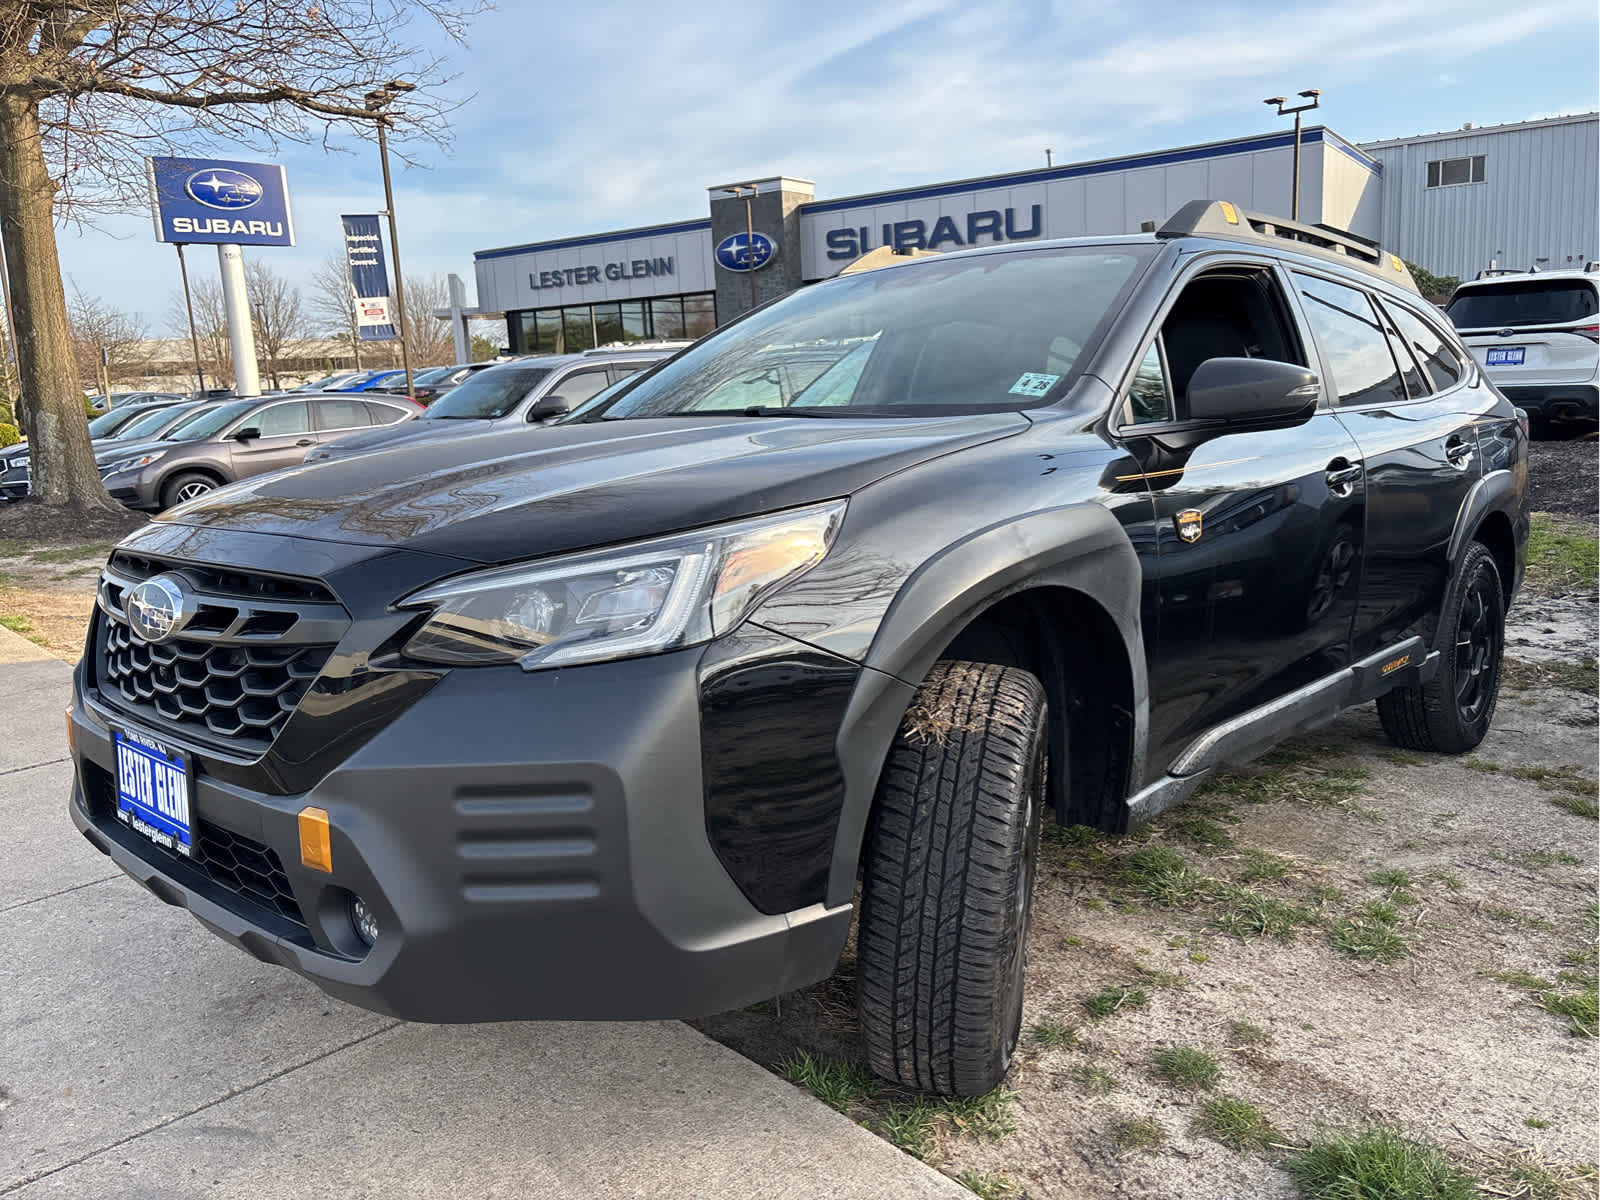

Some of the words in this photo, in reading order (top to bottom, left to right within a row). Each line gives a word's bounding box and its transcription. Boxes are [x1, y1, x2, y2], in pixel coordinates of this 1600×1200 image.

[173, 217, 283, 237] SUBARU
[826, 204, 1042, 261] SUBARU
[529, 265, 603, 290] LESTER
[604, 256, 674, 281] GLENN
[1488, 351, 1506, 361] LESTER
[117, 744, 154, 808] LESTER
[155, 761, 190, 827] GLENN
[132, 815, 172, 849] lesterglenn
